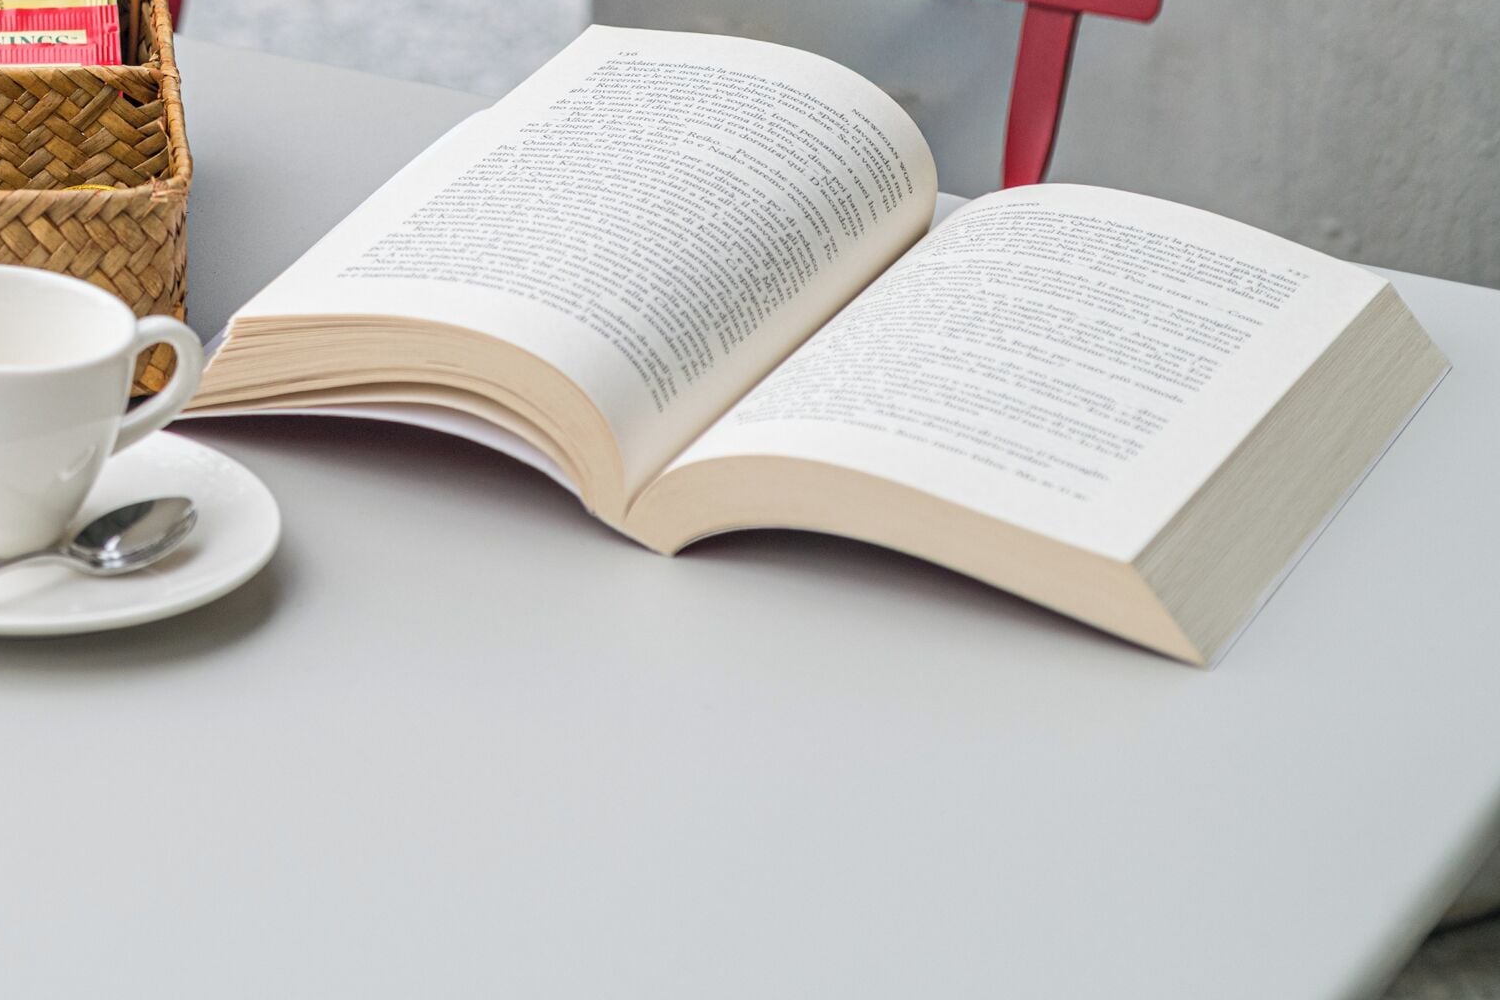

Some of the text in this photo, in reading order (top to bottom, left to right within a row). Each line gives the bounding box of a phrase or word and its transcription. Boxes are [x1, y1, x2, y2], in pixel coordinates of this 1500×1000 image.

[766, 127, 793, 146] letto,
[806, 153, 832, 175] disse
[830, 175, 847, 193] poi
[767, 120, 819, 154] ginocchia.
[775, 142, 809, 167] seduti.
[820, 175, 839, 196] Noi
[799, 128, 846, 166] pensando
[852, 175, 870, 199] quei
[806, 112, 834, 134] bene.
[836, 132, 850, 145] Se
[849, 144, 861, 157] tu
[861, 156, 885, 193] venissi
[881, 193, 892, 214] qui
[817, 110, 849, 134] spazio
[850, 134, 862, 144] ci
[861, 145, 897, 208] sentiremmo
[851, 123, 891, 171] lavorando
[851, 107, 913, 194] NORWEGIAN WOOD
[735, 147, 768, 169] Penso
[768, 167, 788, 182] che
[788, 181, 830, 233] torneremo
[746, 164, 785, 191] saremo
[786, 192, 822, 240] occupate.
[750, 207, 778, 234] corpo
[786, 159, 806, 176] qui.
[808, 176, 850, 236] D'accordo?
[743, 226, 793, 300] passeggiata in
[758, 203, 788, 231] chiusi
[784, 231, 799, 246] gli
[795, 246, 813, 282] occhi.
[781, 257, 792, 270] di
[788, 271, 800, 294] una
[784, 215, 796, 227] di
[795, 228, 819, 275] tedesco.
